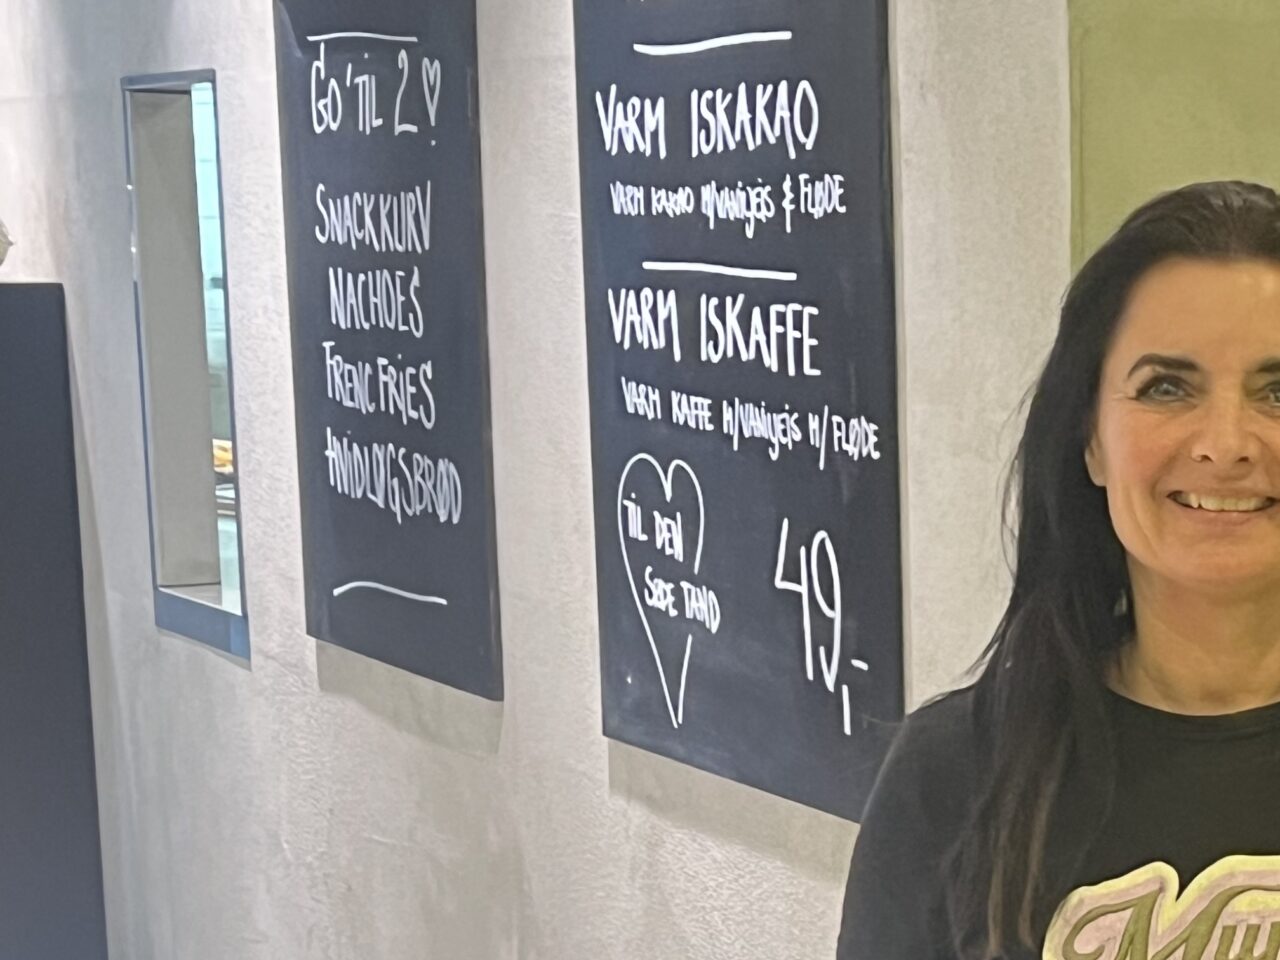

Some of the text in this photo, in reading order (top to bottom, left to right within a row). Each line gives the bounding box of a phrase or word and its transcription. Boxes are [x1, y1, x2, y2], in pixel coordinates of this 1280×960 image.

[394, 48, 418, 136] 2
[595, 79, 819, 159] VARM ISKAKAO
[315, 180, 431, 254] SNACKKURV
[329, 266, 423, 338] NACHOES
[608, 287, 822, 377] VARM ISKAFFE
[653, 510, 684, 562] DEN
[680, 580, 721, 635] TAND
